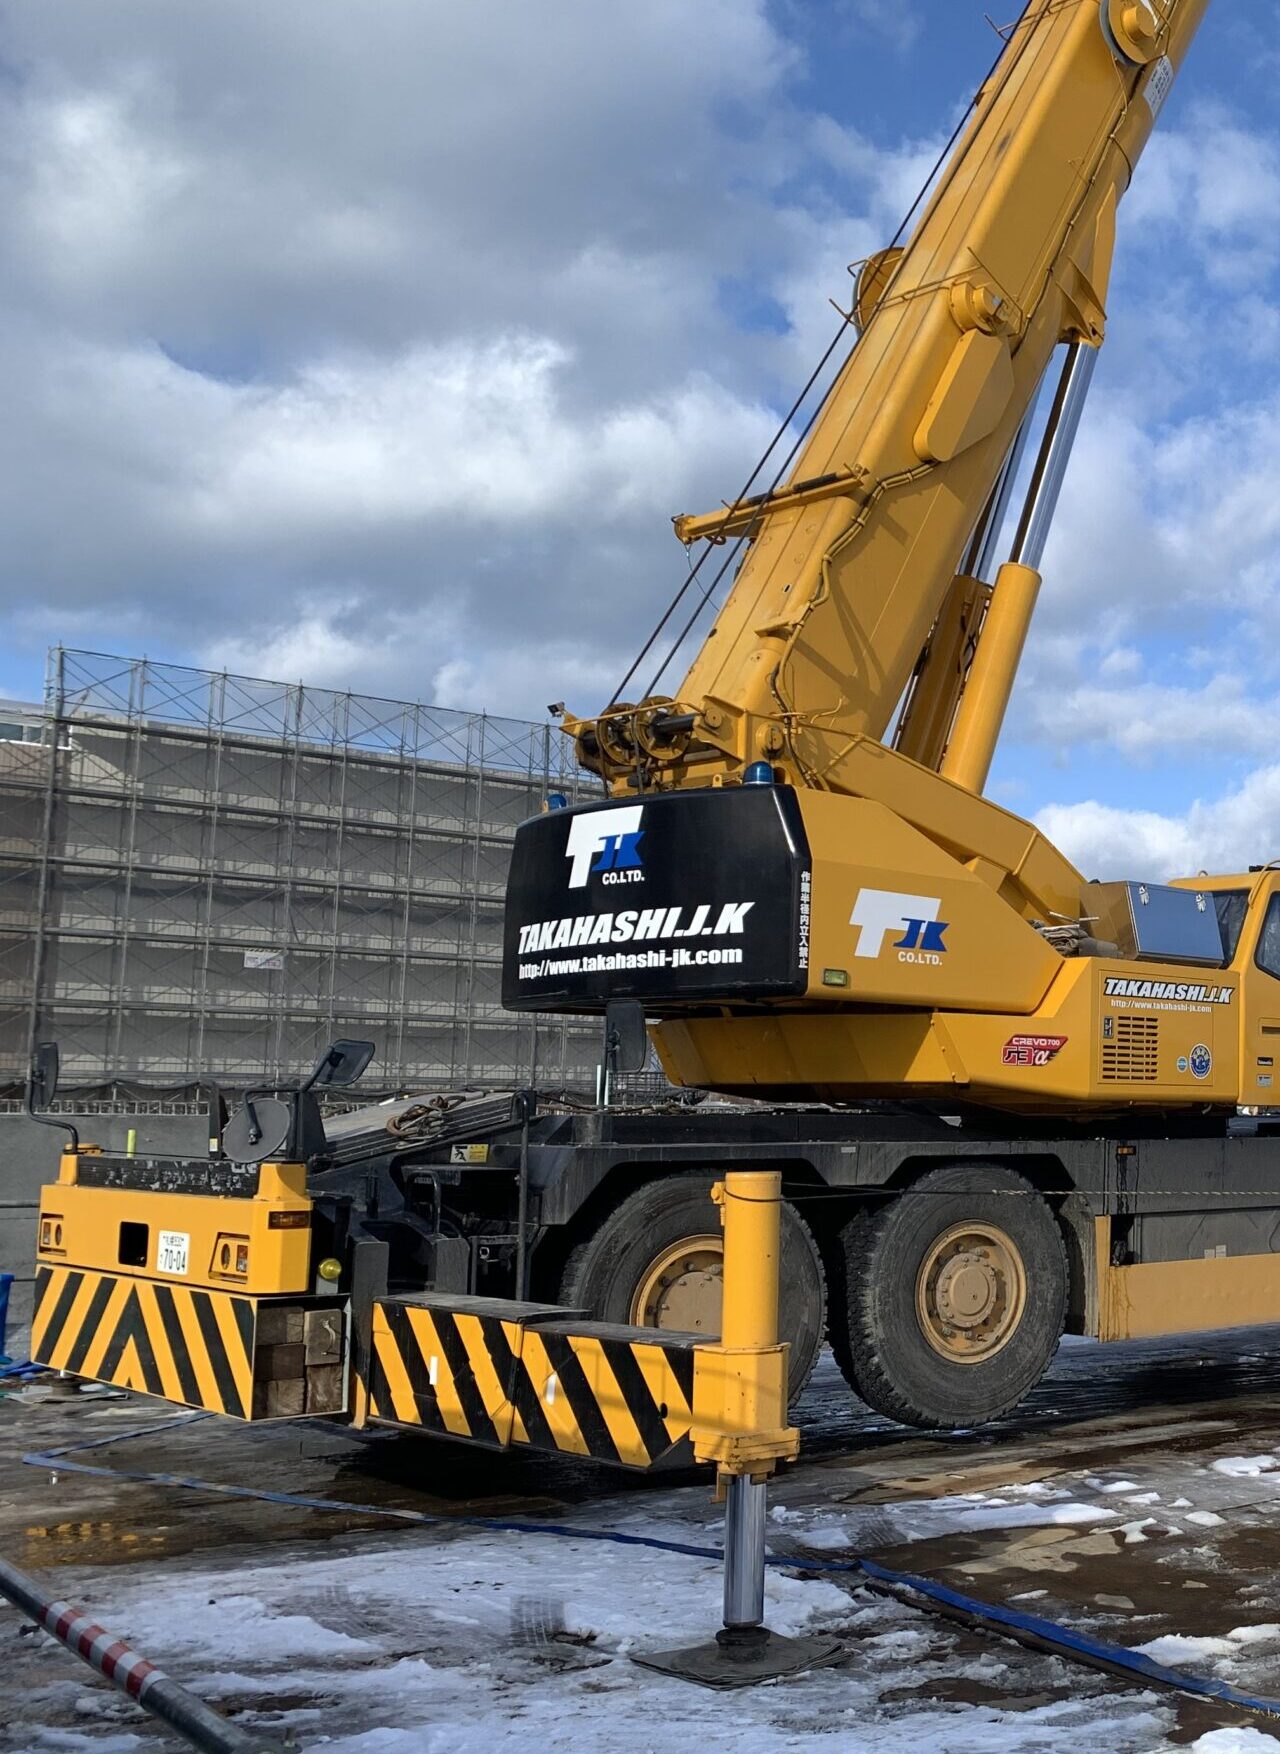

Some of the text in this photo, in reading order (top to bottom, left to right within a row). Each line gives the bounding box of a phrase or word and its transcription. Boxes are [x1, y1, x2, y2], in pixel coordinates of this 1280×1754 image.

[602, 870, 645, 885] CO.LTD.
[518, 902, 755, 954] TAKAHASHI.J.K
[519, 948, 742, 979] http://www.takahashi-jk.com
[898, 951, 942, 965] CO.LTD.
[1012, 1037, 1047, 1046] CREVO
[164, 1248, 186, 1271] 70-04
